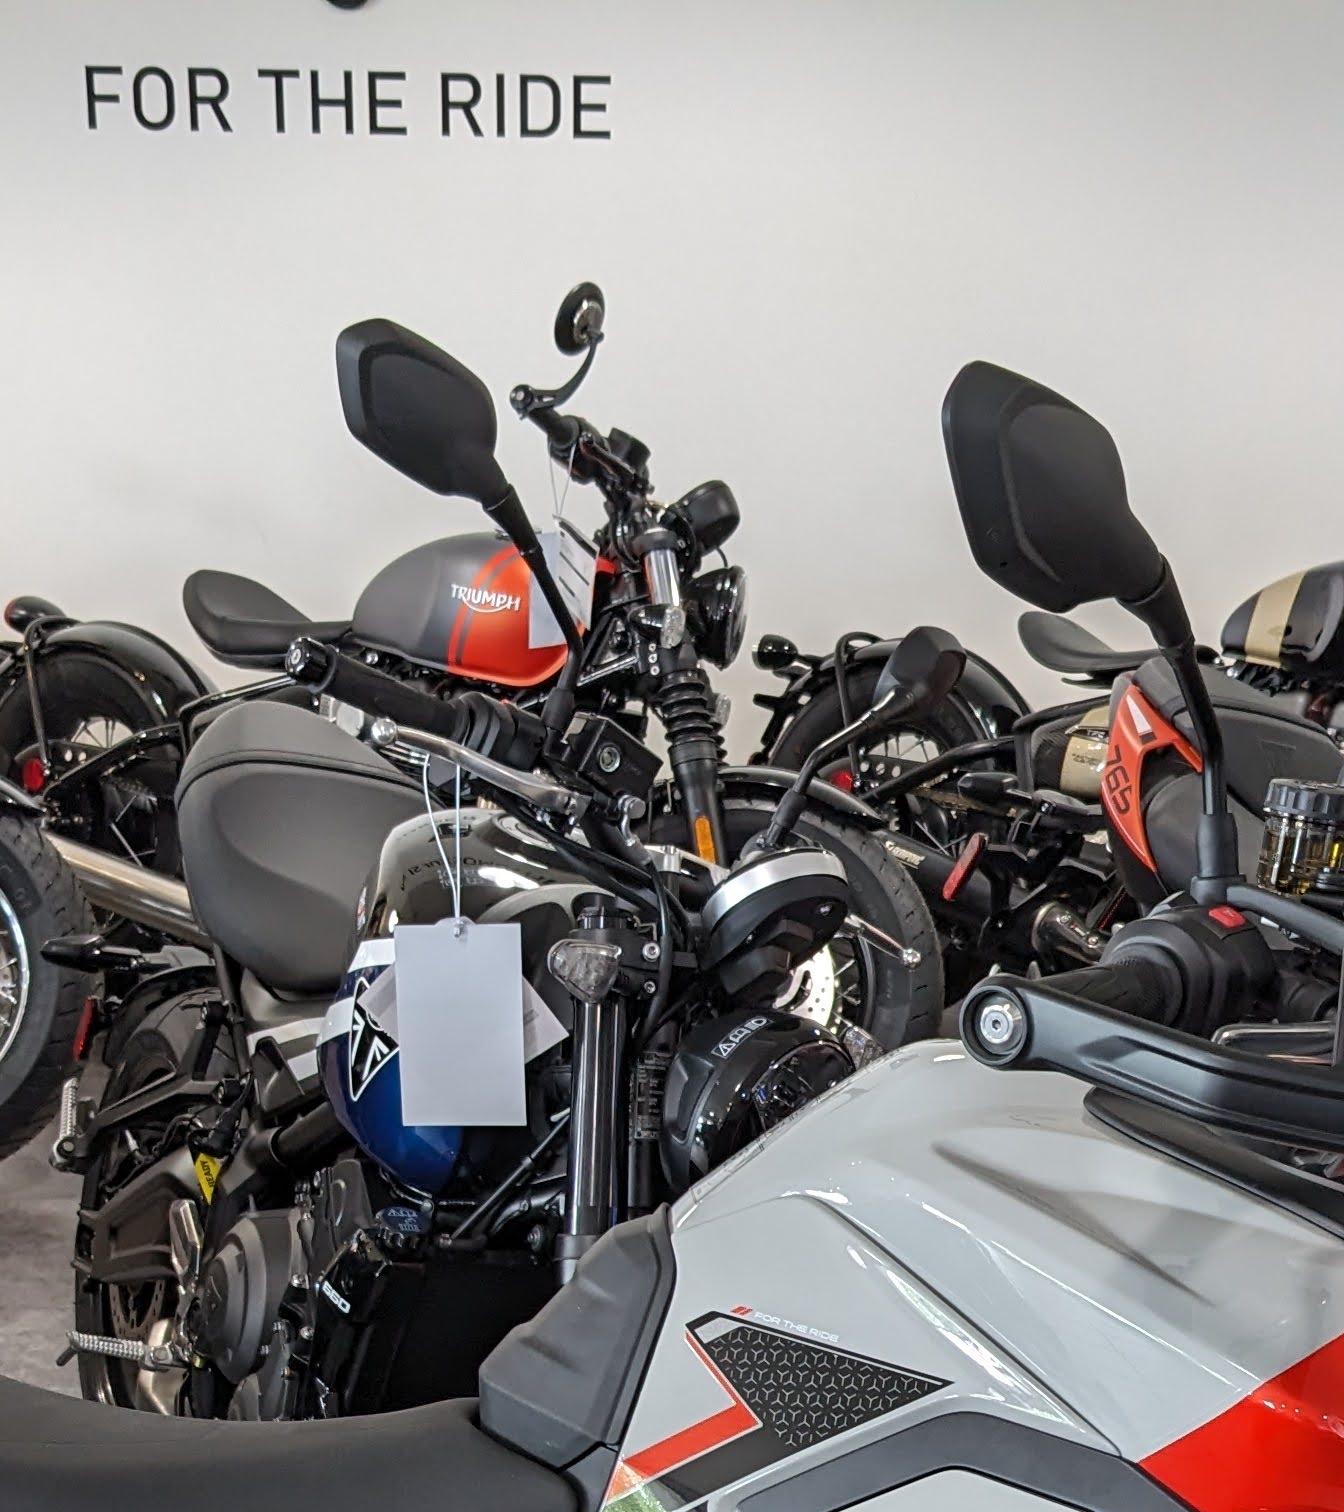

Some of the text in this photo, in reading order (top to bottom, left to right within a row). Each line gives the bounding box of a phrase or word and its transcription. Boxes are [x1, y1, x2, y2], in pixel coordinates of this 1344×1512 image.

[85, 65, 612, 139] FOR THE RIDE
[451, 583, 522, 612] TRIUMPH
[1106, 743, 1133, 815] 765
[754, 1311, 840, 1343] FOR THE RIDE
